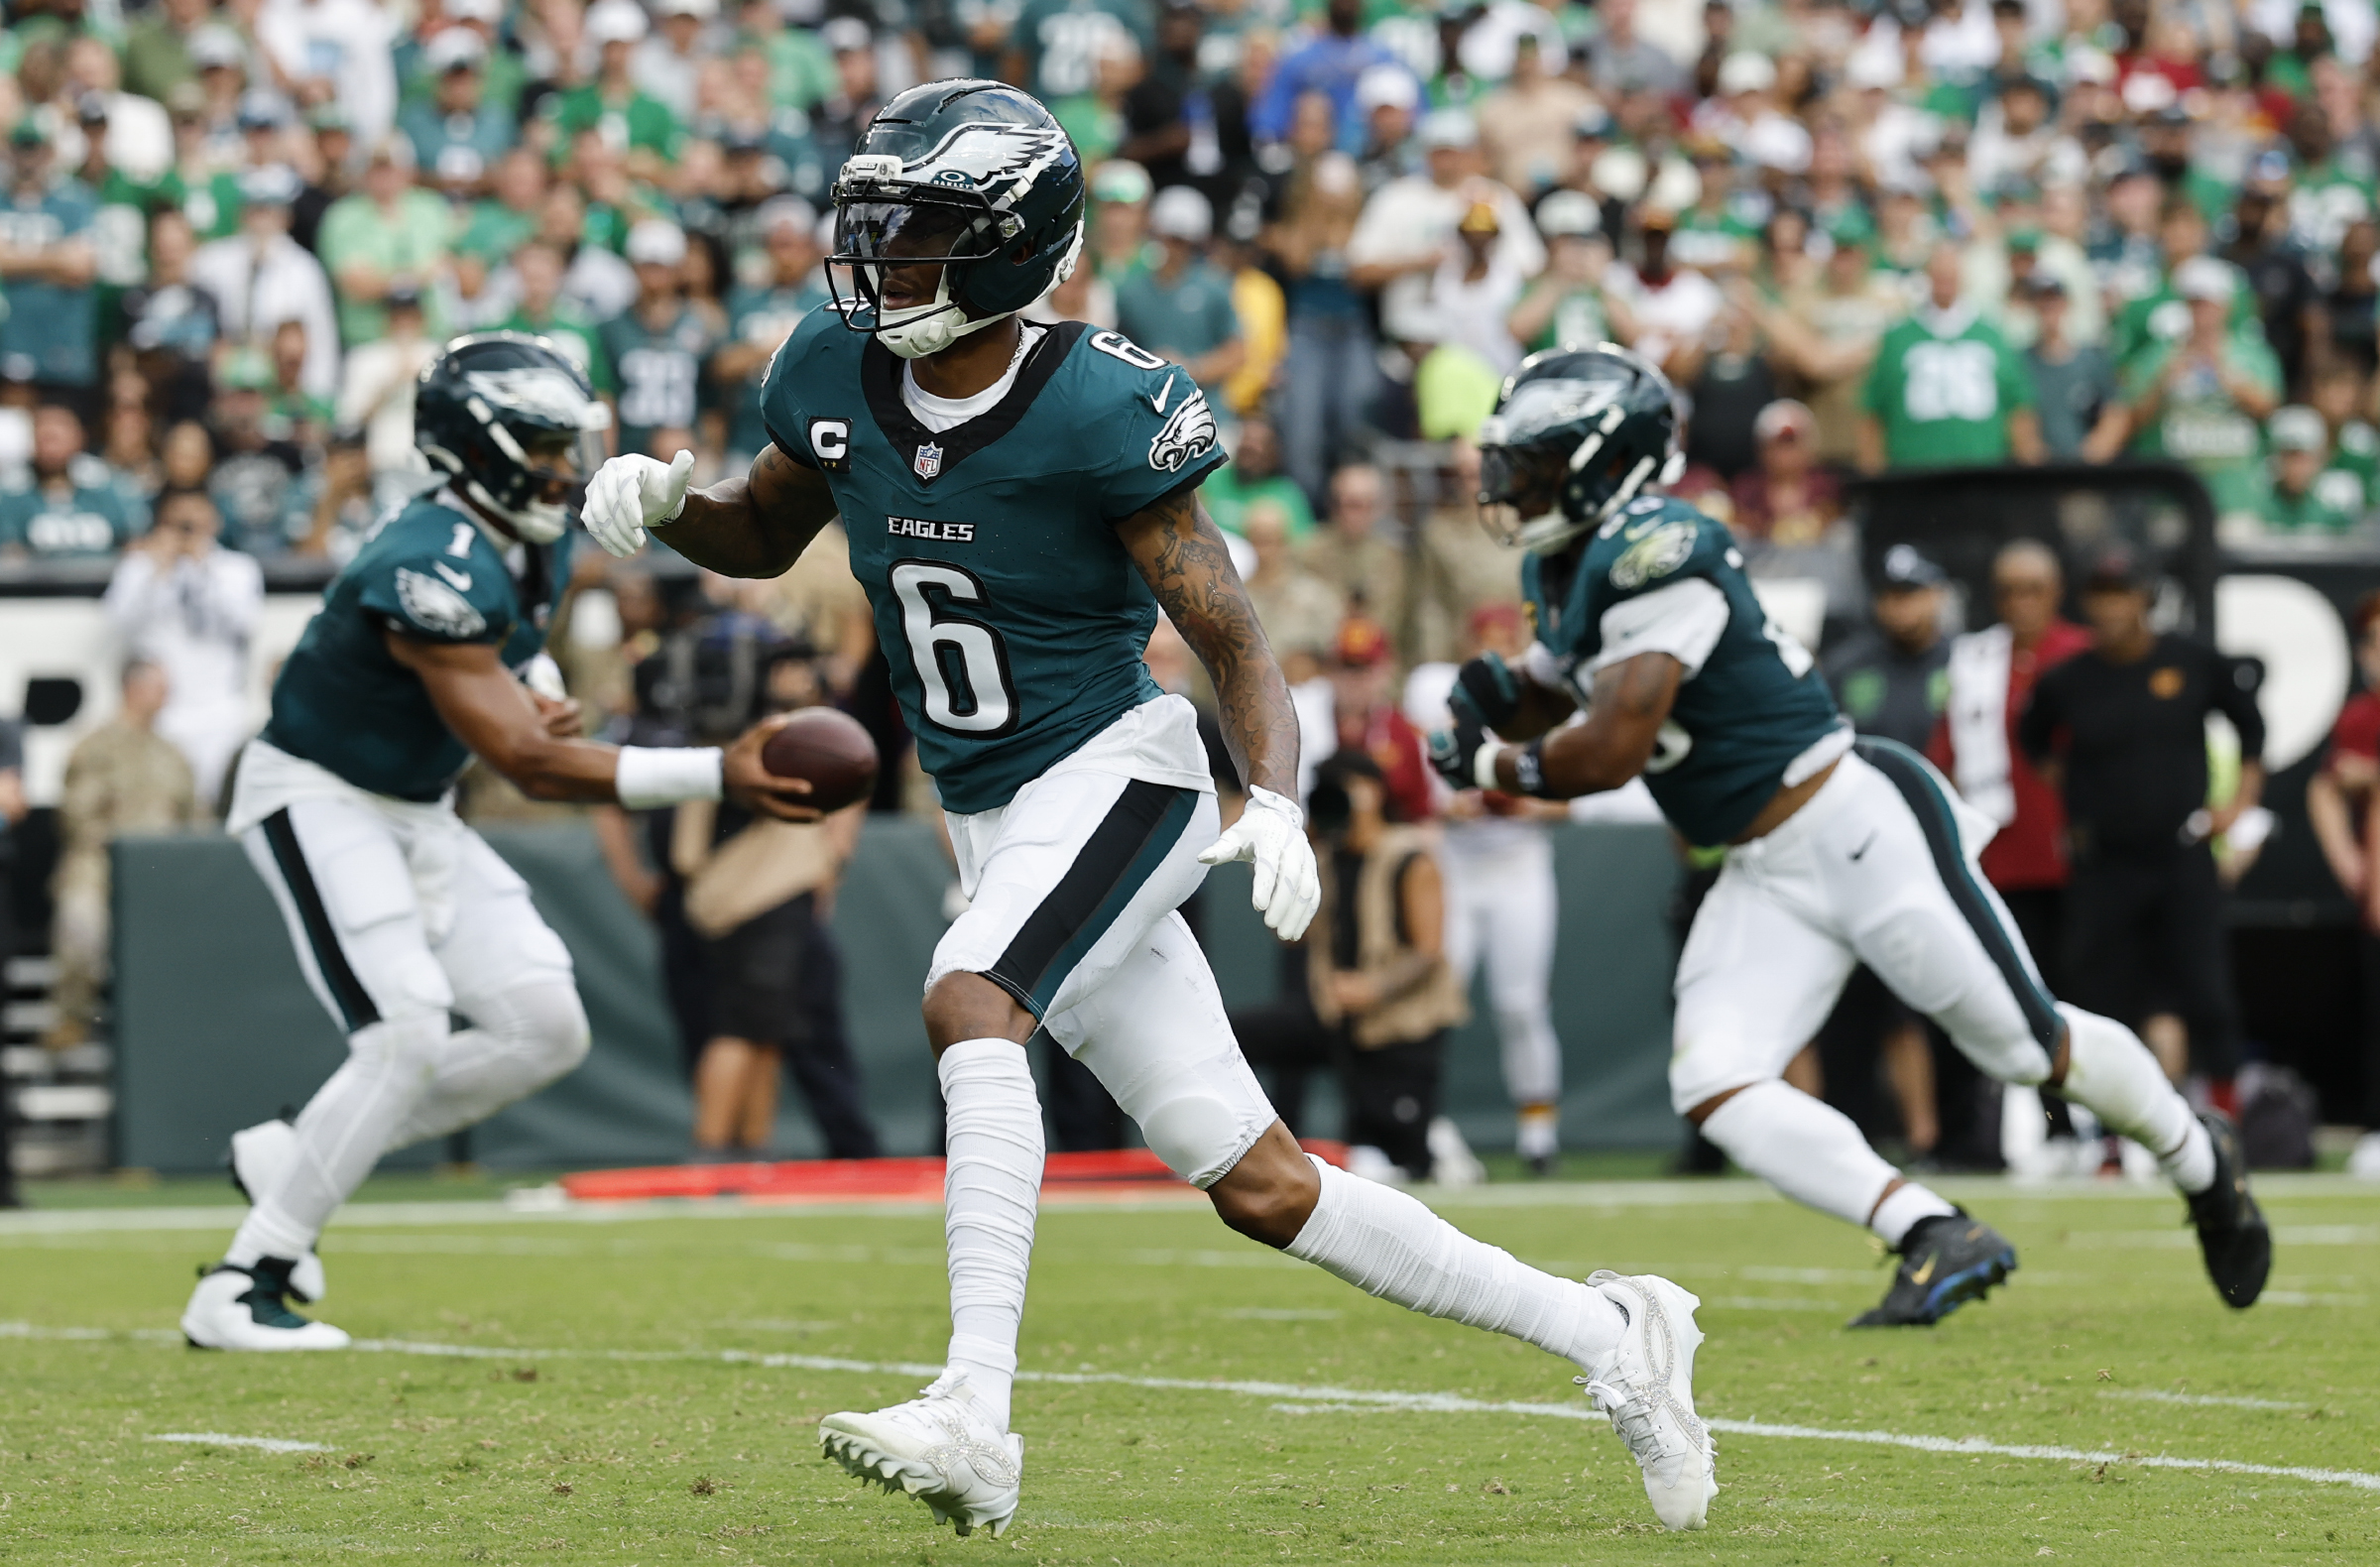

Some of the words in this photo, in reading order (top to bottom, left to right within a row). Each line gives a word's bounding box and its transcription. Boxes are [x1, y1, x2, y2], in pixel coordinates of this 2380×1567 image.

[933, 180, 971, 189] OAKLEY
[1088, 330, 1169, 370] 6
[810, 421, 848, 459] C
[918, 458, 937, 473] NFL
[446, 522, 476, 559] 1
[888, 516, 975, 542] EAGLES
[889, 558, 1019, 739] 6
